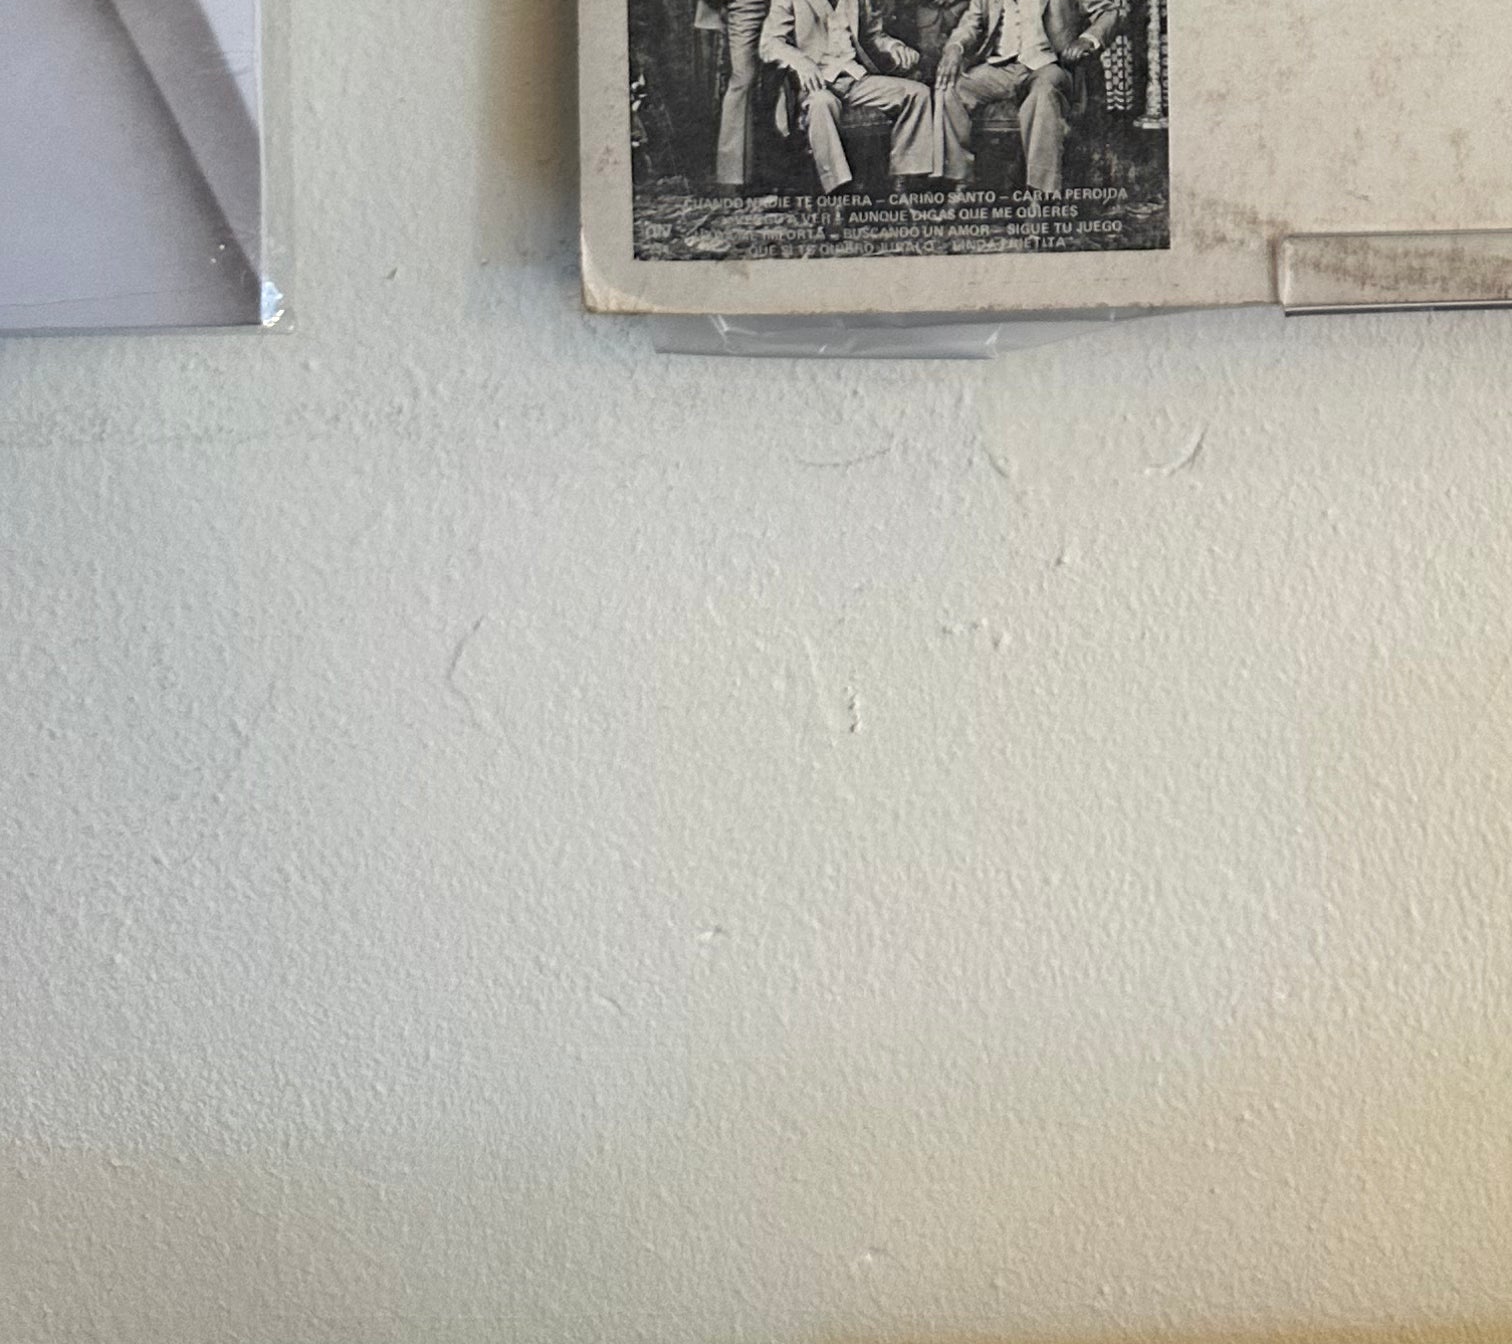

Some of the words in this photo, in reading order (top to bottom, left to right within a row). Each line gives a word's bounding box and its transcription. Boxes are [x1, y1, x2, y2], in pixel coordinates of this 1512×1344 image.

[796, 195, 812, 209] TE
[818, 194, 872, 208] QUIERA
[889, 192, 944, 205] CARIÑO
[949, 190, 996, 203] SANTO
[1013, 189, 1061, 202] CARTA
[1065, 187, 1128, 202] PERDIDA
[849, 209, 909, 223] AUNQUE
[959, 207, 988, 219] QUE
[992, 206, 1012, 218] ME
[1016, 204, 1079, 219] QUIERES
[924, 225, 944, 238] UN
[948, 223, 990, 236] AMOR
[1006, 222, 1049, 235] SIGUE
[1053, 222, 1073, 234] TU
[1076, 220, 1123, 233] JUEGO
